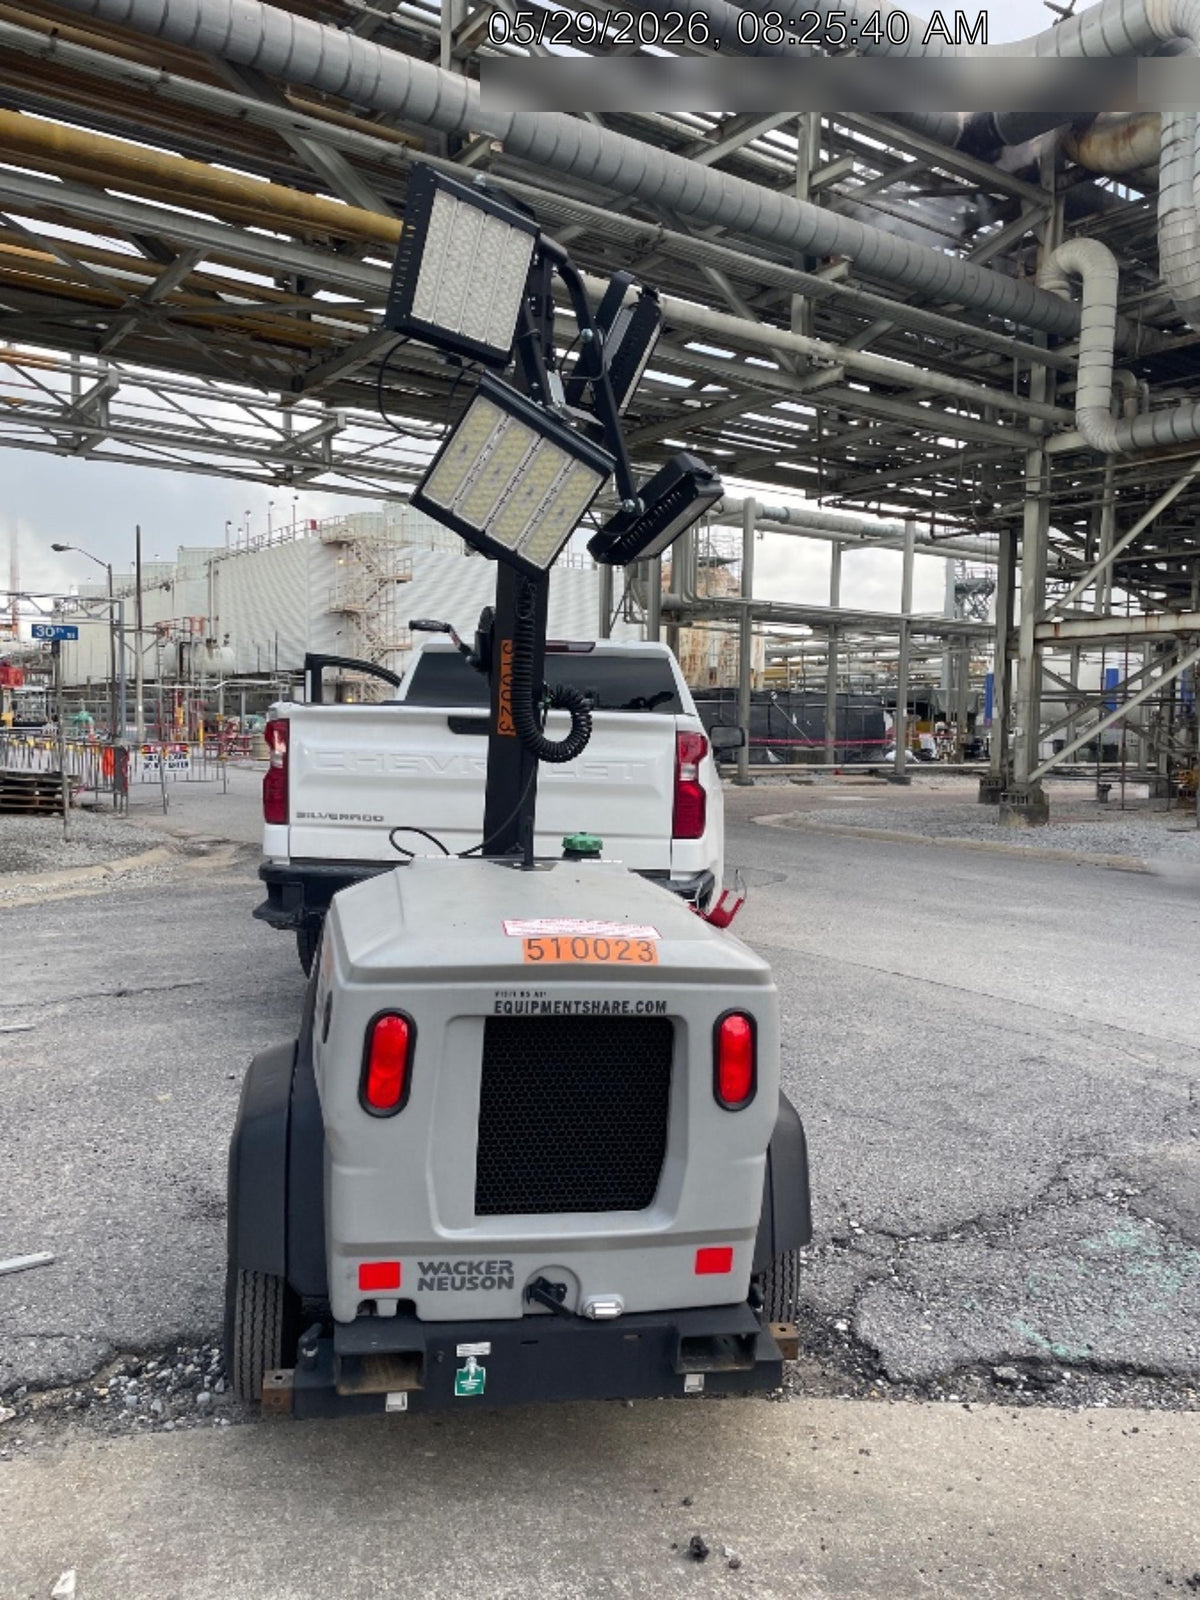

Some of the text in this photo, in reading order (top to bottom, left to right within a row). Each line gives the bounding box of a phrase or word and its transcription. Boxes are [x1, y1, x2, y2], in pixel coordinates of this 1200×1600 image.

[312, 751, 649, 780] CHEVRLET
[296, 811, 384, 822] SILVERADO
[527, 937, 654, 962] 510023
[494, 1000, 667, 1014] EQUIPMENTSHARE.COM
[417, 1260, 514, 1275] WACKER
[417, 1276, 514, 1291] NEUSON
